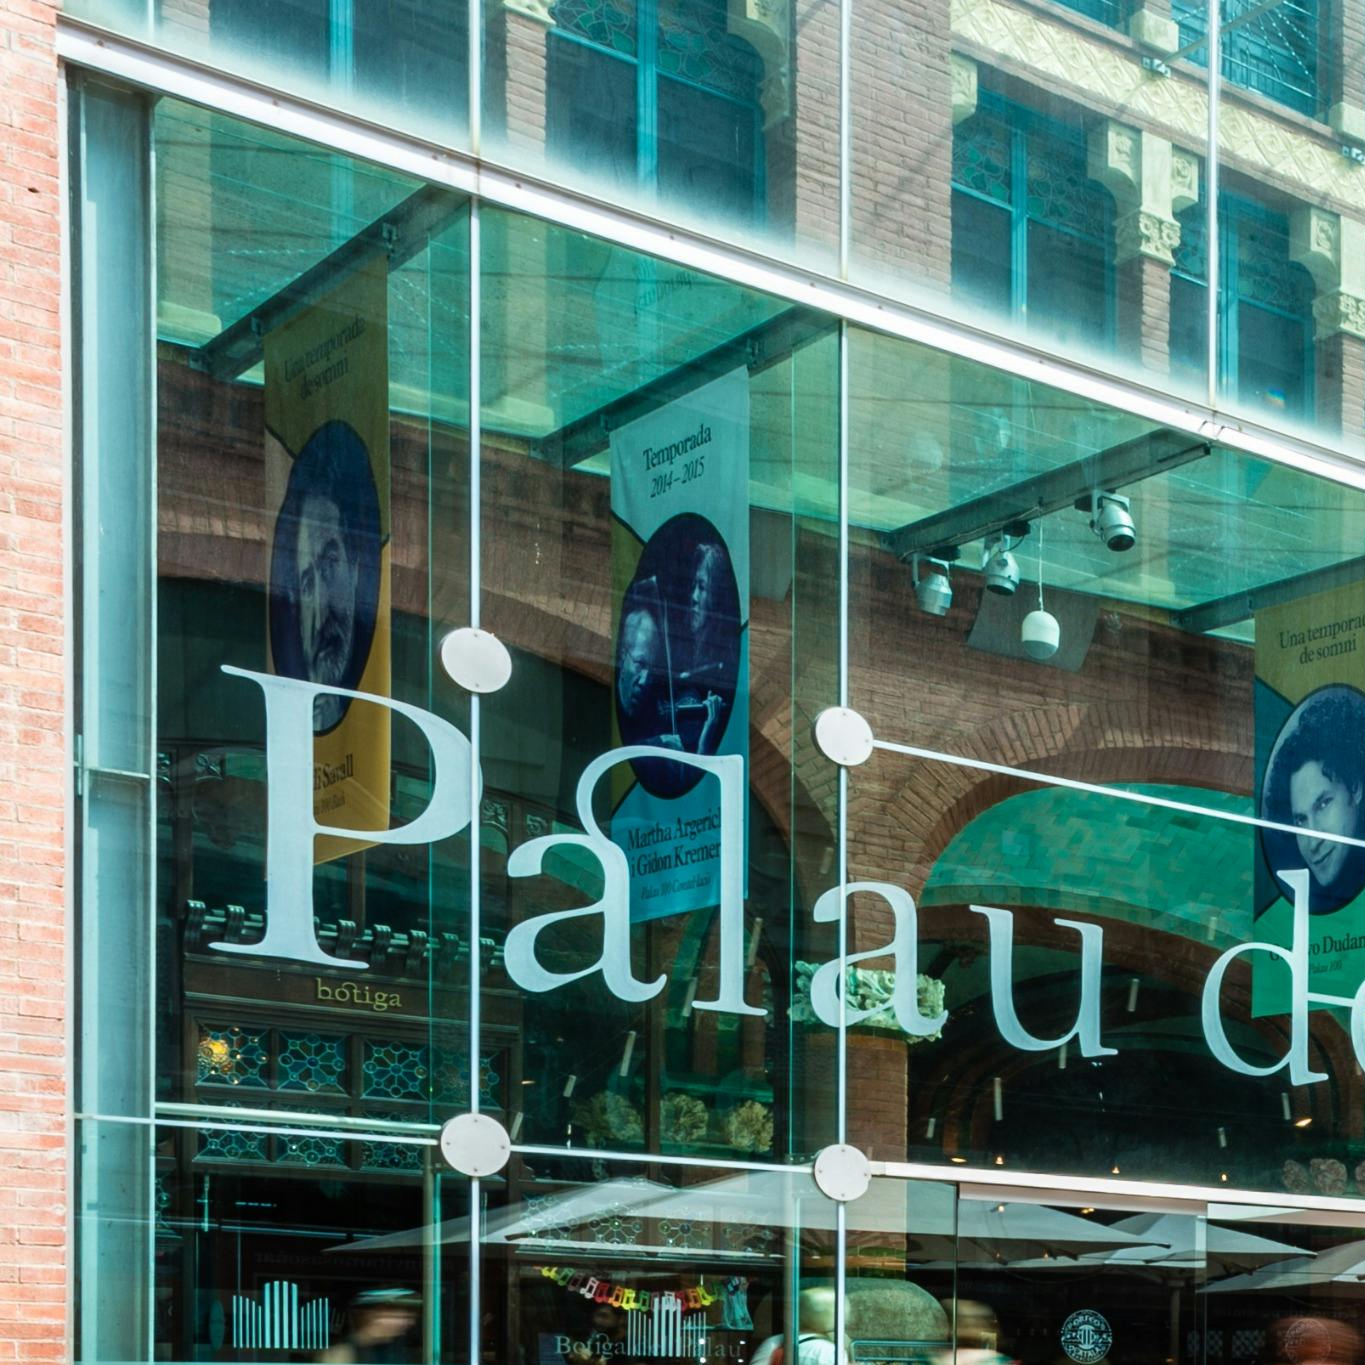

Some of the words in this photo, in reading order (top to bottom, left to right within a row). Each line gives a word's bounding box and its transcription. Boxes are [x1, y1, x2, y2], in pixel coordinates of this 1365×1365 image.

[642, 423, 712, 472] Temporada
[1279, 630, 1306, 649] Una
[1299, 646, 1315, 665] de
[1316, 633, 1357, 659] somni
[627, 821, 673, 851] Martha
[209, 664, 1118, 1058] Palau
[637, 850, 672, 877] Gidon
[673, 842, 721, 868] Kremer
[316, 977, 402, 1012] botiga
[554, 1330, 626, 1360] Botiga
